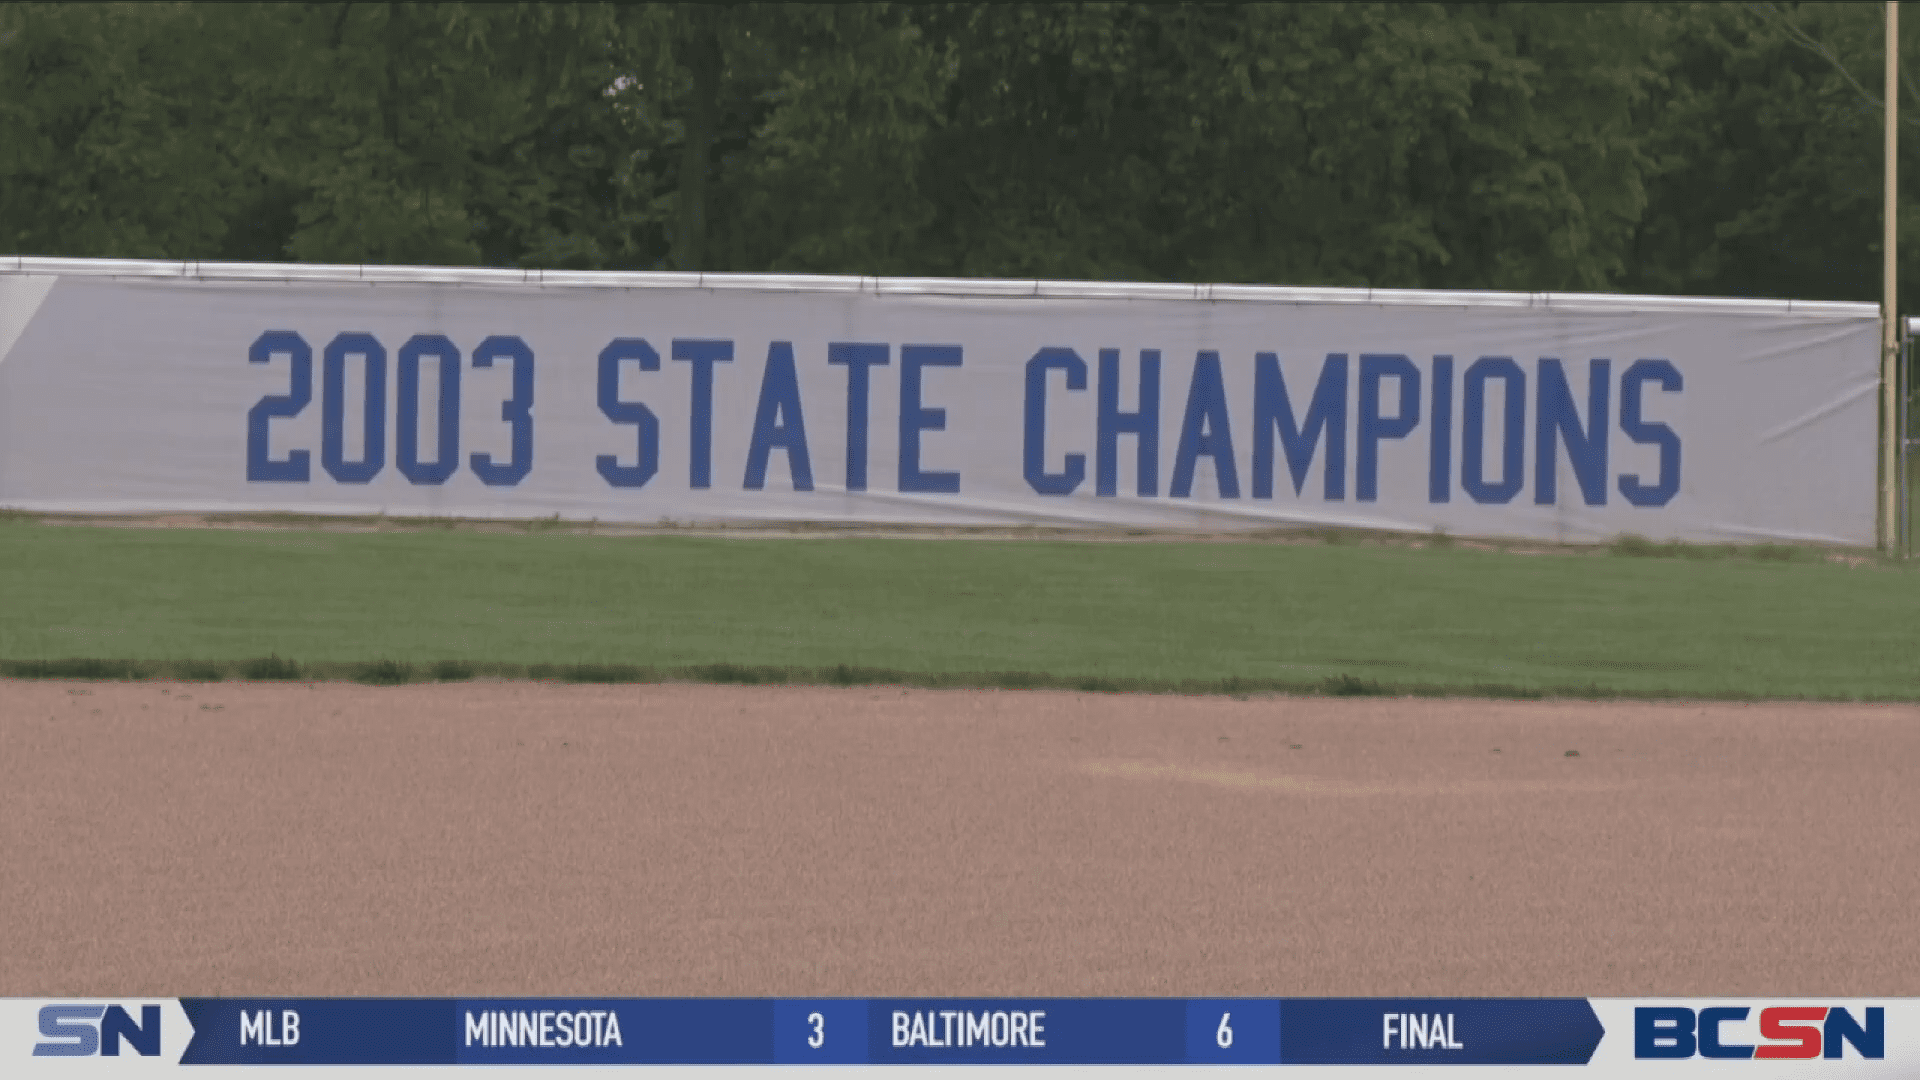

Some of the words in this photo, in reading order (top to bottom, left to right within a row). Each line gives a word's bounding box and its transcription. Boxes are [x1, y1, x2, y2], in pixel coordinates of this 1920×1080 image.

[246, 330, 536, 487] 2003
[595, 336, 963, 494] STATE
[1023, 346, 1684, 507] CHAMPIONS
